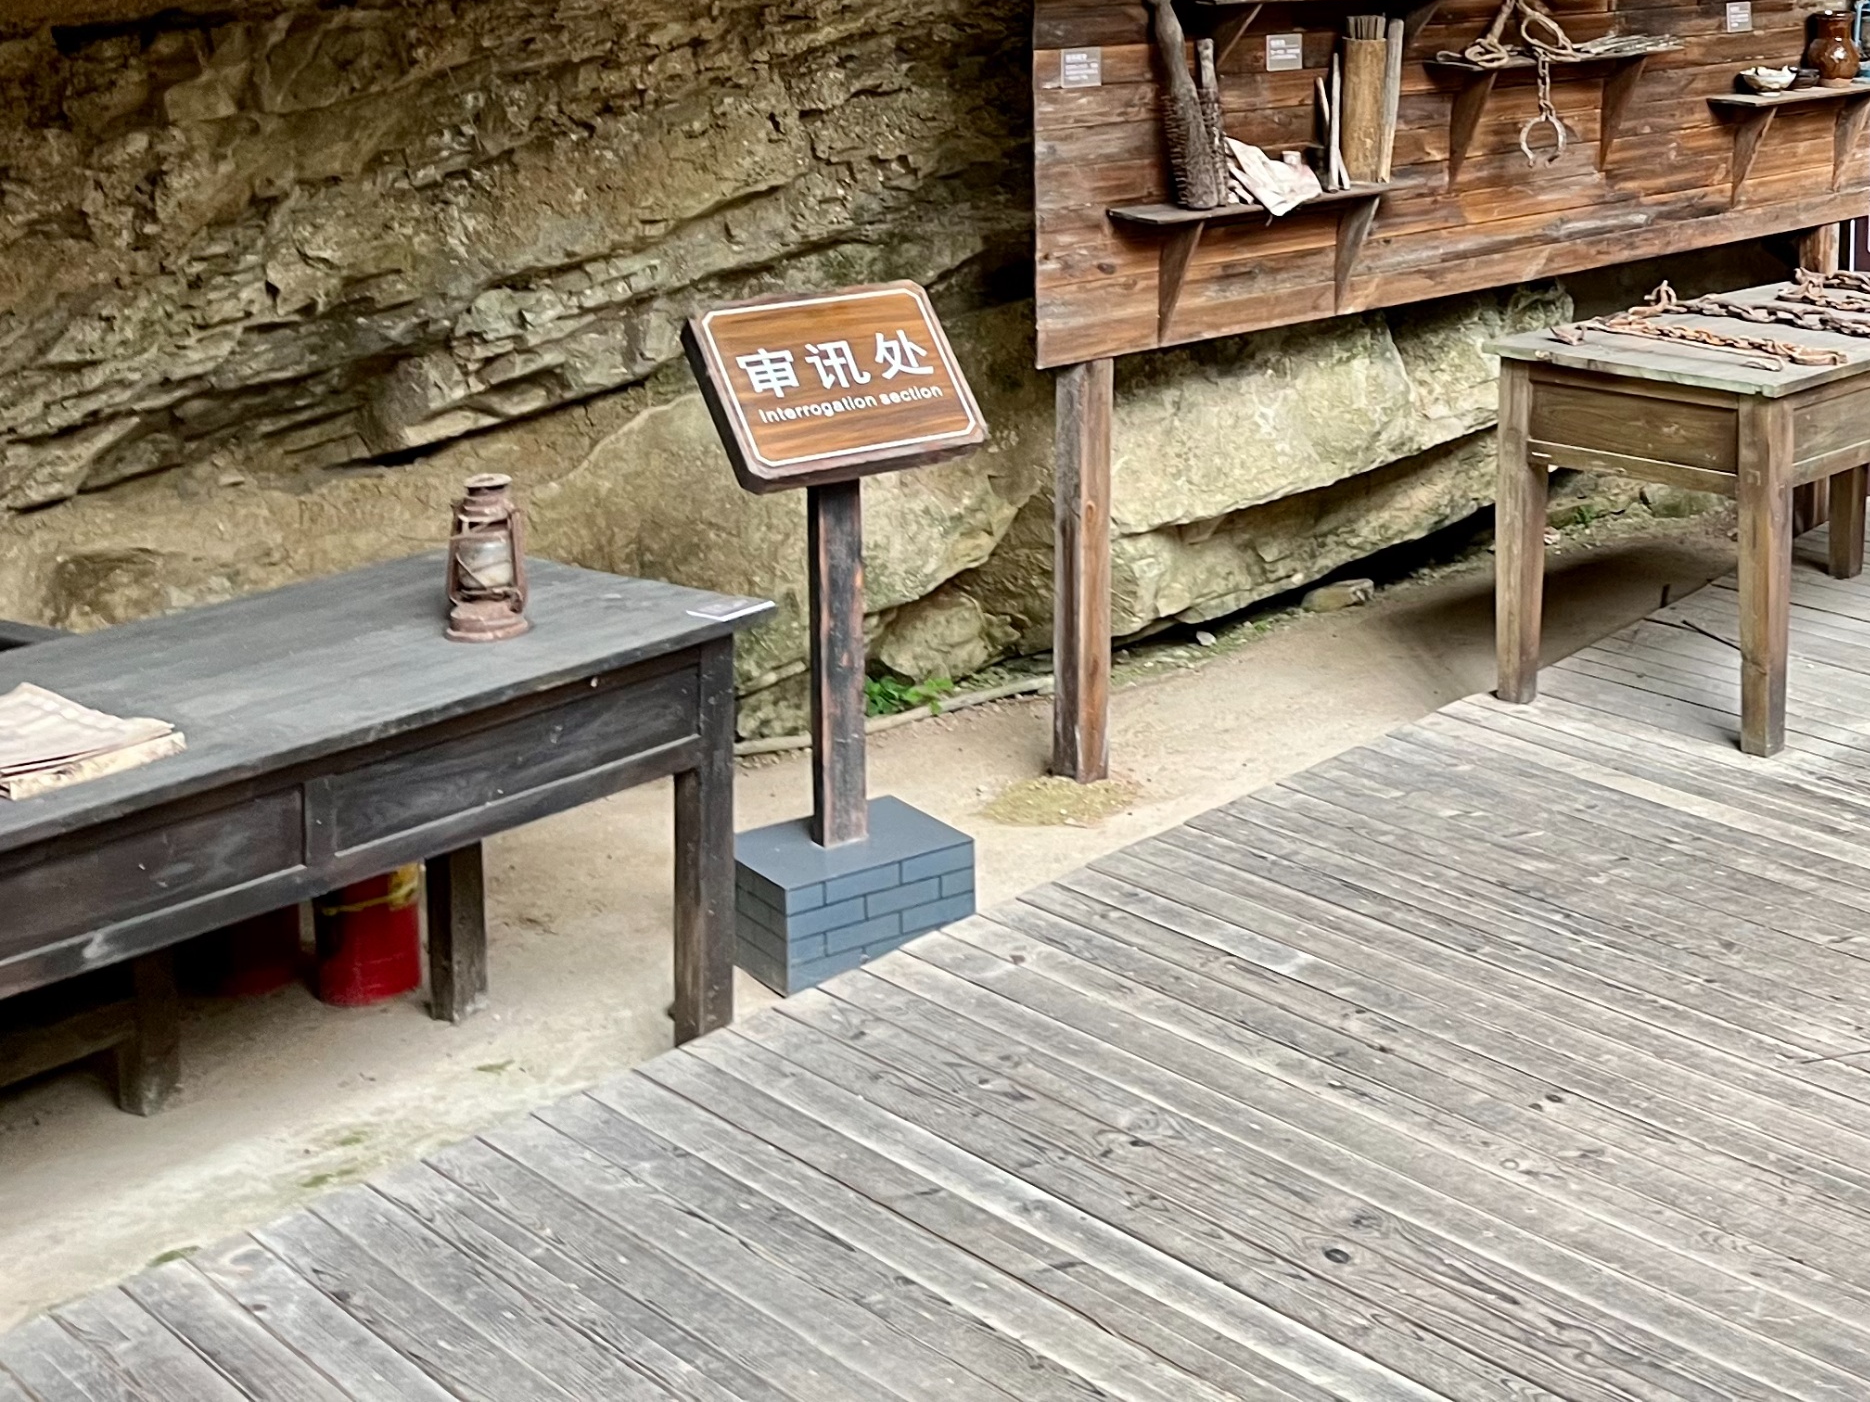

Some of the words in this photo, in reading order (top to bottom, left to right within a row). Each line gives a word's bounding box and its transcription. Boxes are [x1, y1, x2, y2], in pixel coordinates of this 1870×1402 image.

[735, 329, 935, 399] 审讯处
[758, 395, 879, 424] Interrogation
[879, 384, 943, 406] section
